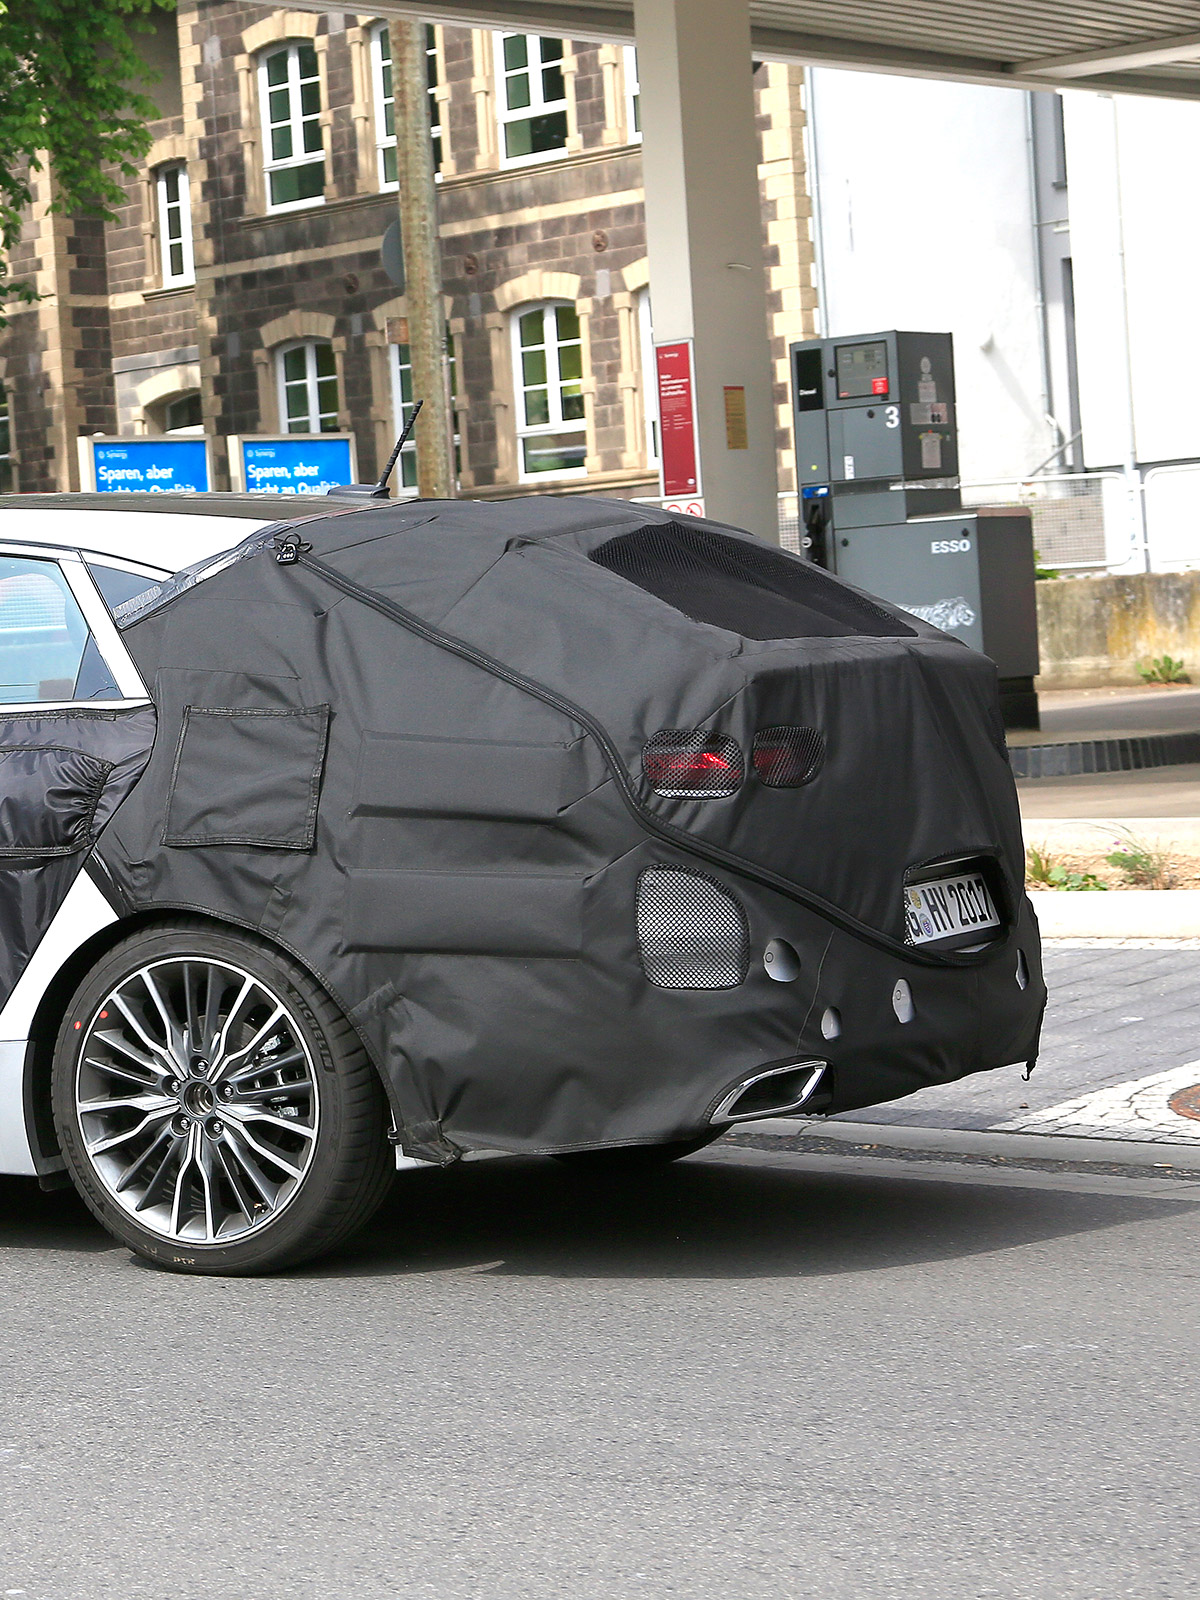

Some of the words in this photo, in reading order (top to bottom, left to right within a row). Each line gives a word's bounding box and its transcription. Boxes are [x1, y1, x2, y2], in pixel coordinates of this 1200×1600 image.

[885, 405, 900, 429] 3
[98, 466, 144, 484] Sparen,
[146, 464, 174, 479] aber
[247, 464, 292, 482] Sparen,
[293, 462, 319, 477] aber
[931, 539, 971, 554] ESSO
[921, 886, 955, 932] HY
[947, 879, 993, 927] 2017
[289, 990, 333, 1069] MICHELIN
